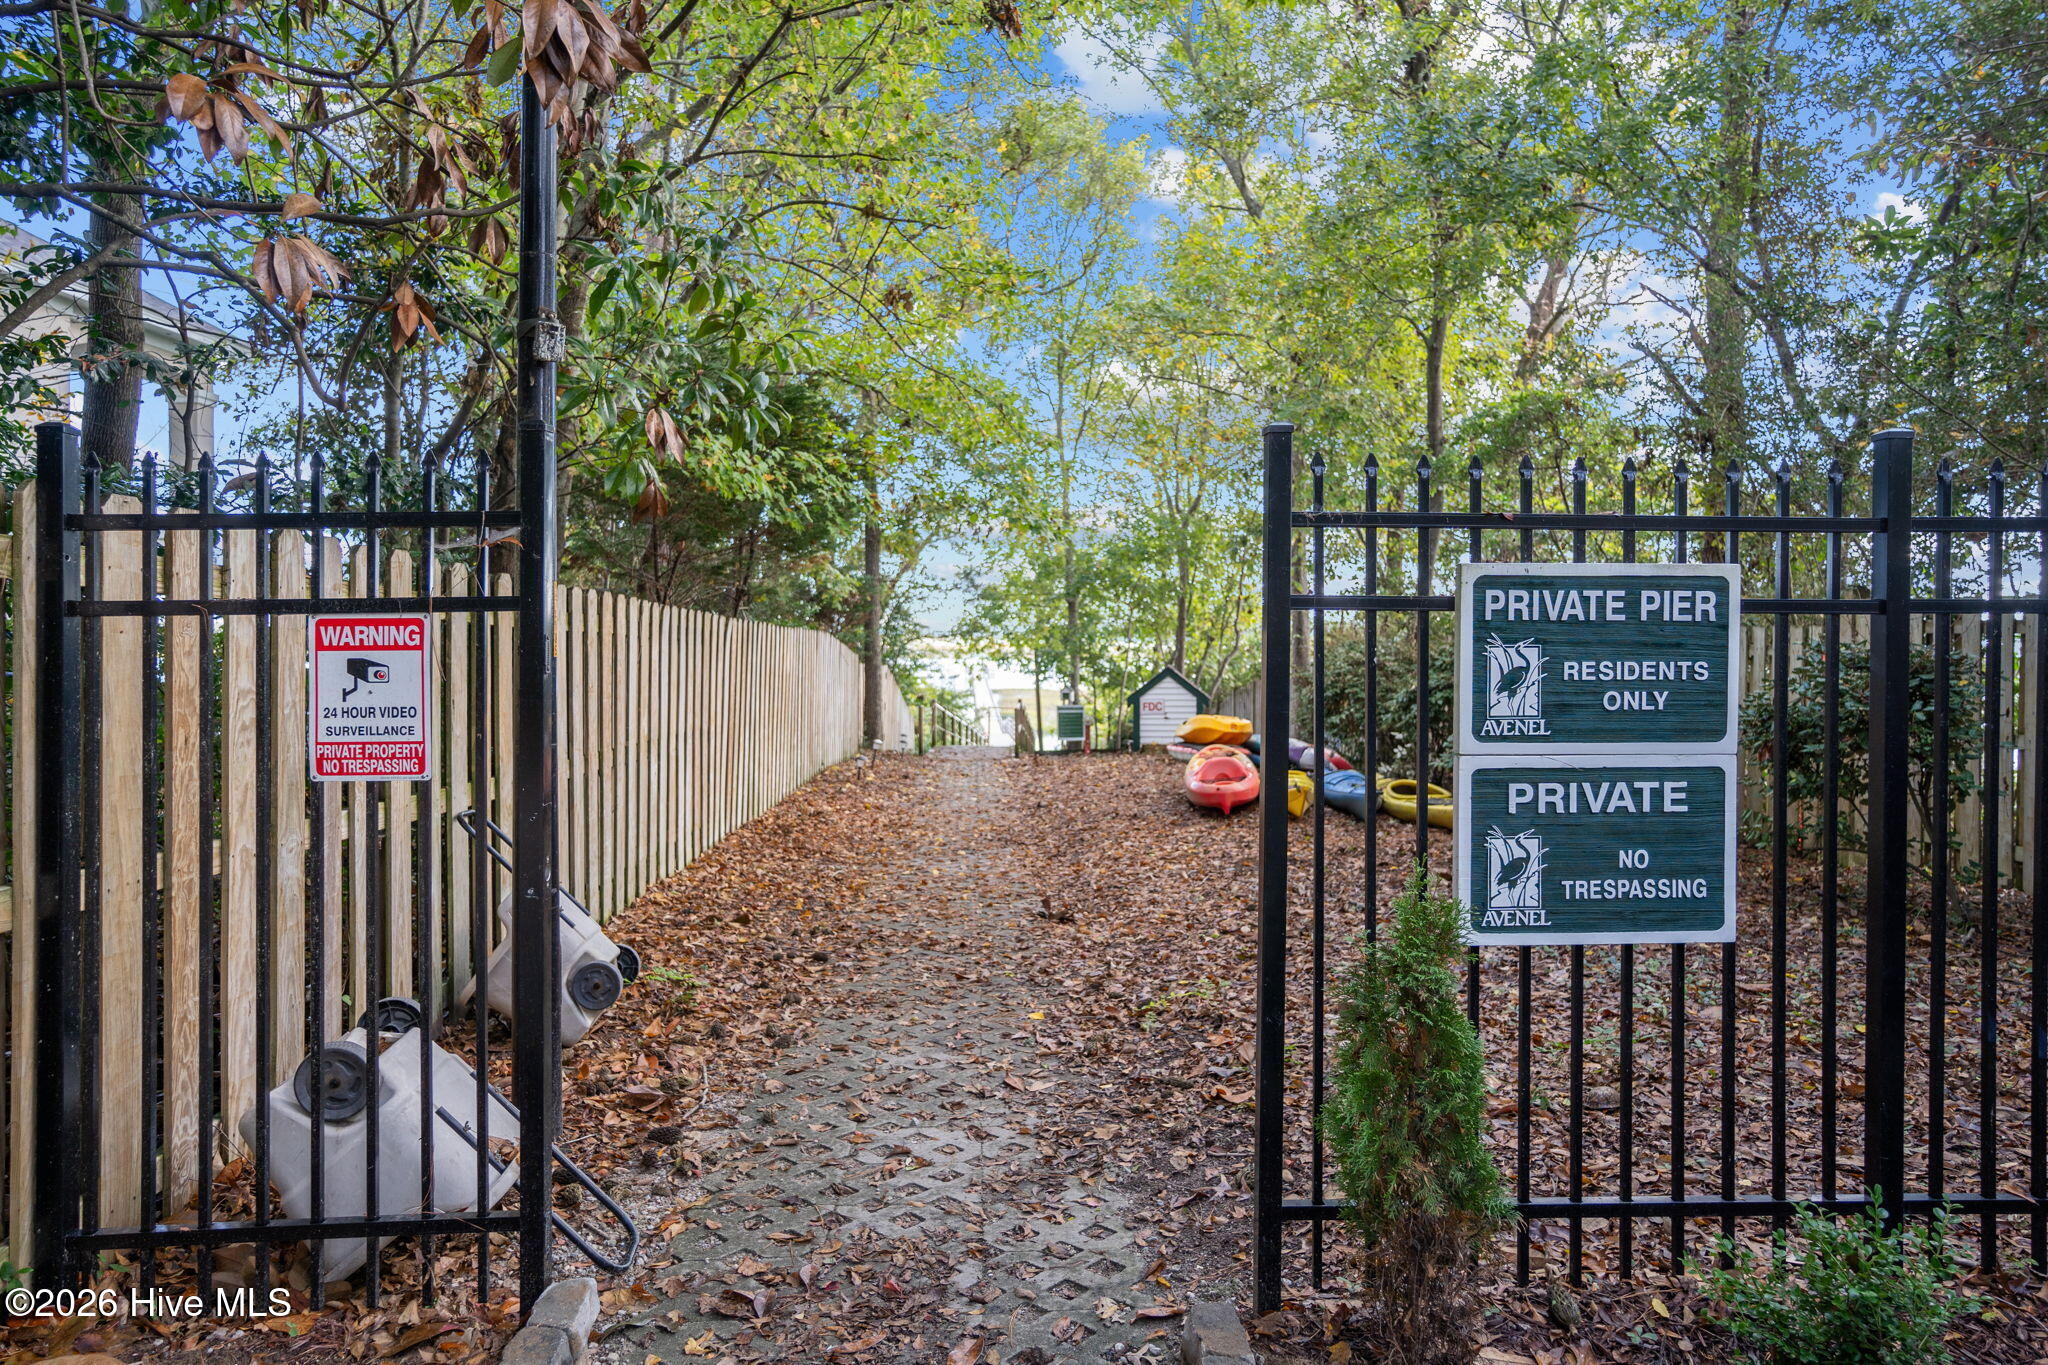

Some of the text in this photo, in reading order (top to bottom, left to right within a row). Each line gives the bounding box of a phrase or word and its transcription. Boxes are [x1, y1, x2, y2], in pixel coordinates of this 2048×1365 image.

[1484, 589, 1717, 622] PRIVATE PIER
[320, 625, 420, 646] WARNING
[1563, 661, 1709, 681] RESIDENTS
[1143, 702, 1162, 711] FDC
[1602, 690, 1669, 711] ONLY
[323, 706, 417, 719] 24 HOUR VIDEO
[325, 726, 415, 736] SURVEILLANCE
[1480, 719, 1551, 736] AVENEL
[316, 743, 424, 758] PRIVATE PROPERTY
[323, 758, 419, 774] NO TRESPASSING
[1508, 781, 1688, 814] PRIVATE
[1619, 849, 1649, 869] NO
[1561, 879, 1707, 900] TRESPASSING
[1481, 910, 1551, 927] AVENEL
